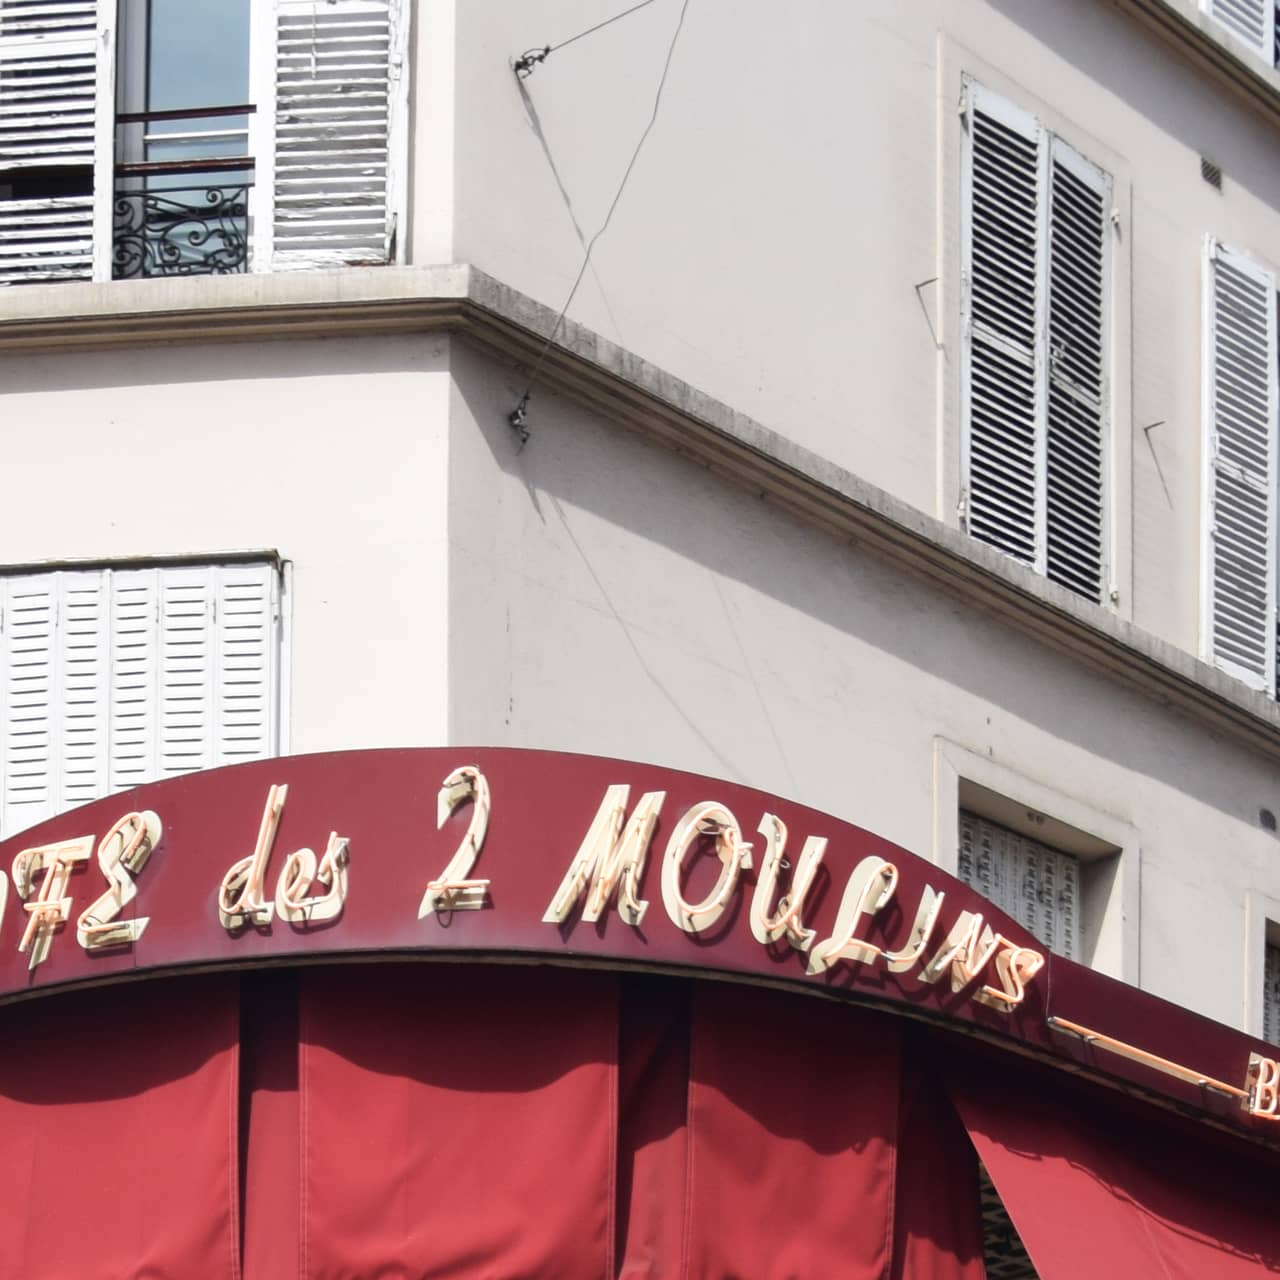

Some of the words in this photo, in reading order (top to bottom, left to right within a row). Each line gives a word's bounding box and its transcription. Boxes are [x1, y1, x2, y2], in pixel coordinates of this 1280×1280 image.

[219, 784, 350, 931] des
[417, 766, 491, 920] 2
[541, 783, 1045, 1013] MOULINS
